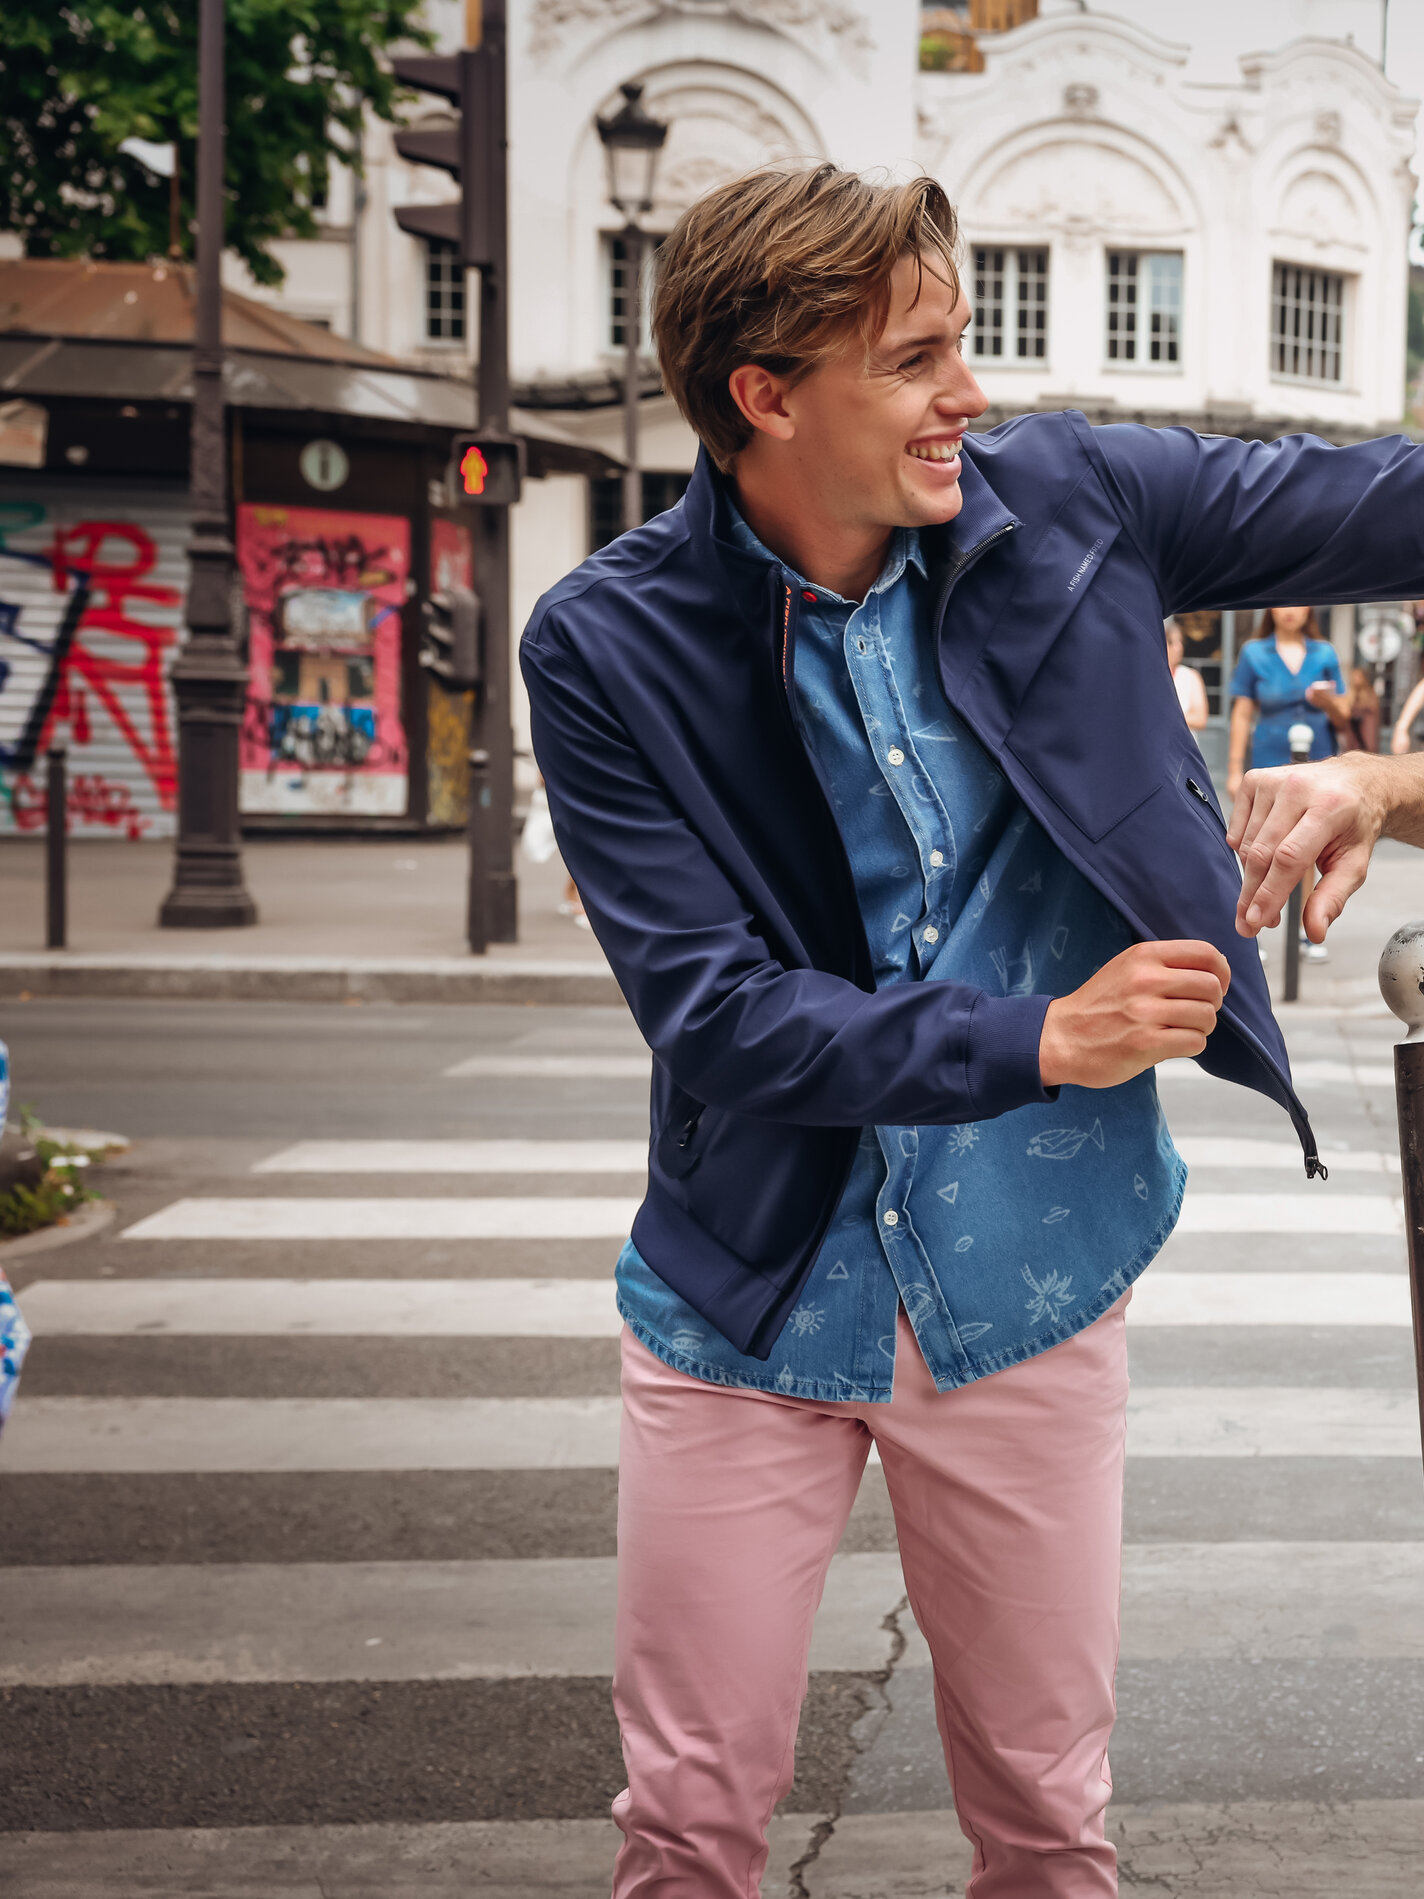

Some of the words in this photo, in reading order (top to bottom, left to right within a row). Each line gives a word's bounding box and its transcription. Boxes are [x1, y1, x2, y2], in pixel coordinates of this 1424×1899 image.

[1069, 572, 1082, 587] FISH
[1078, 553, 1094, 574] NAMED
[1089, 538, 1104, 555] FRED
